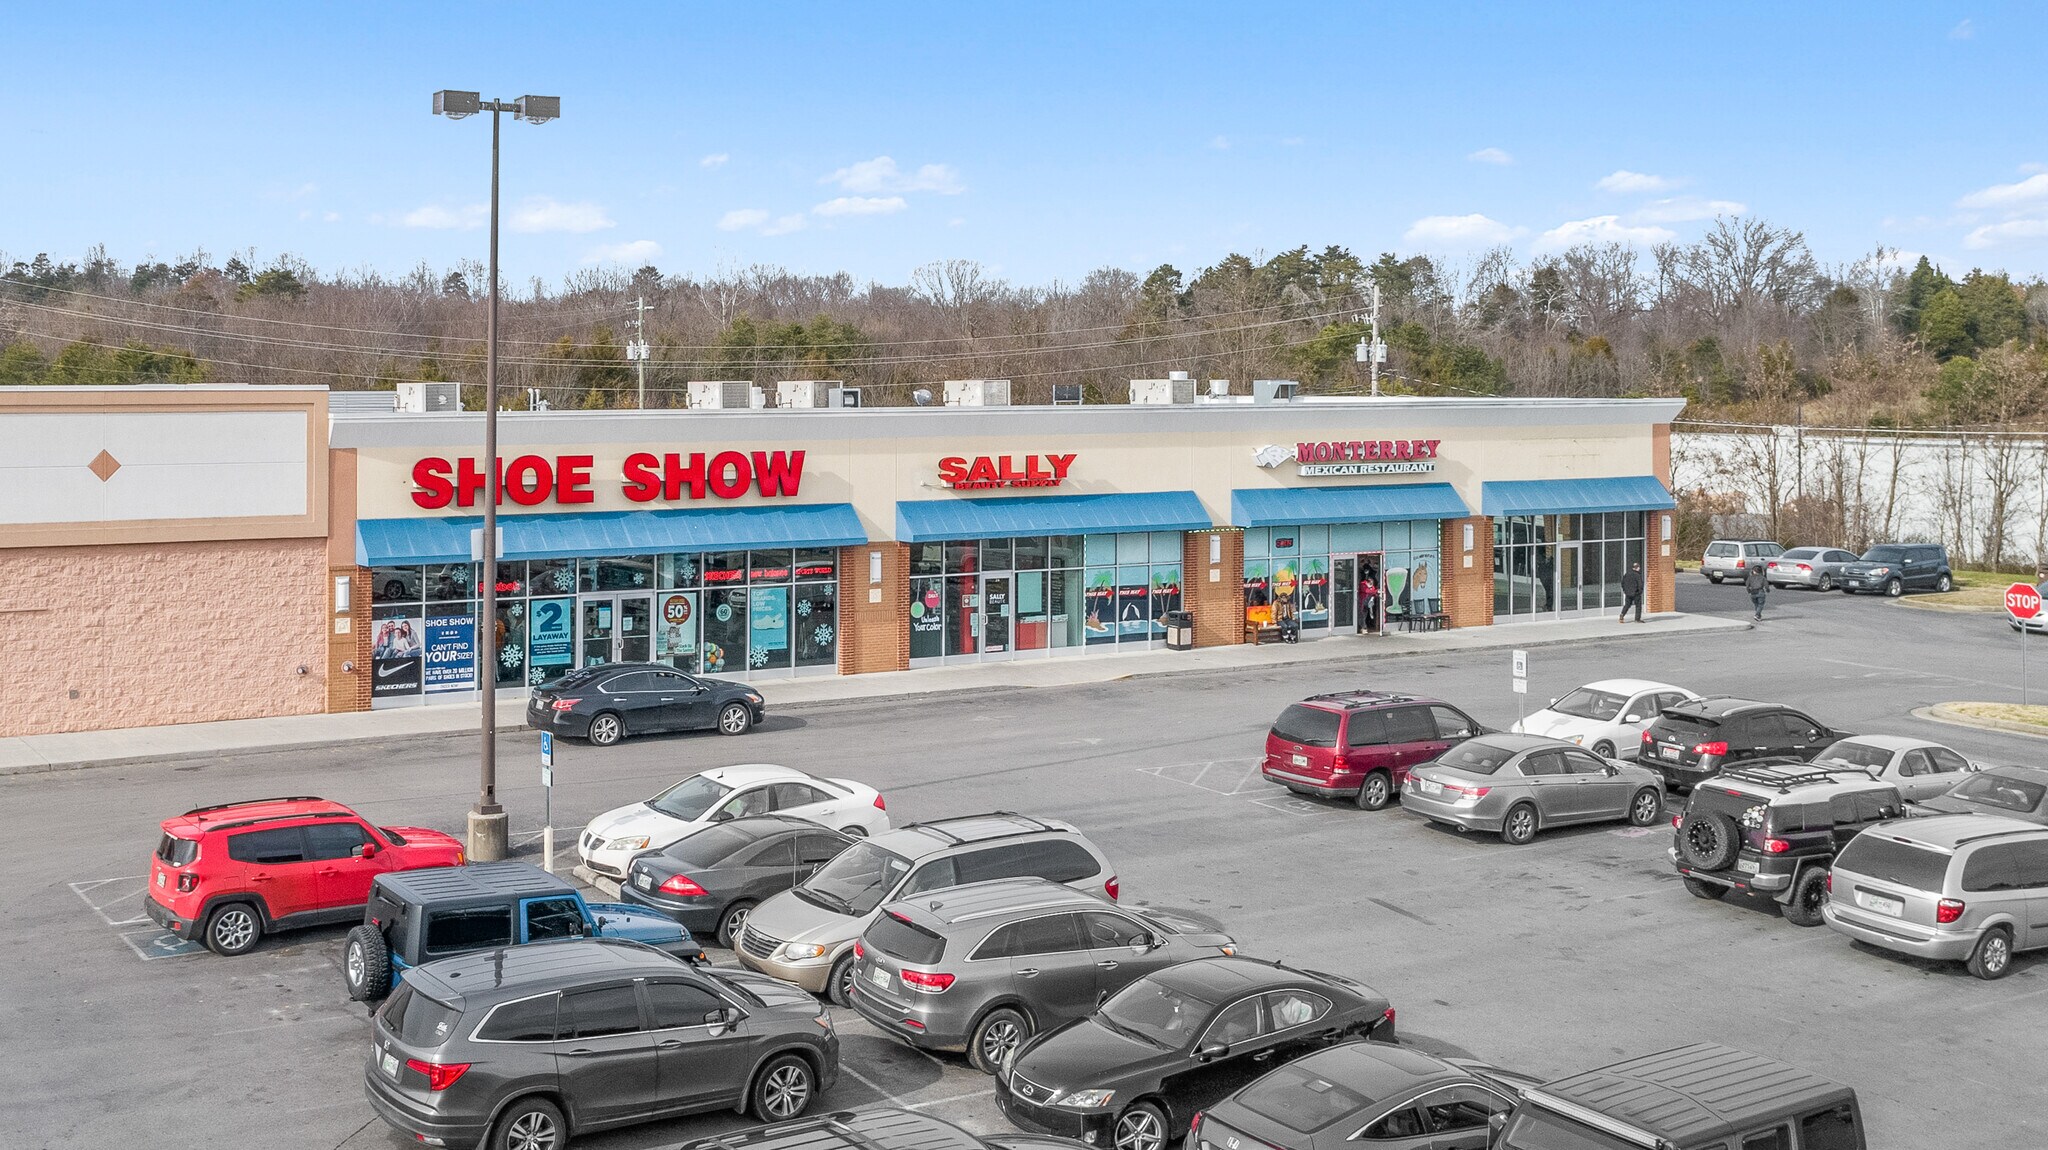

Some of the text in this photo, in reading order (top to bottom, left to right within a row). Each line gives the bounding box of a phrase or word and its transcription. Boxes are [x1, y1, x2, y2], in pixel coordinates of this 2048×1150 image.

[1296, 440, 1441, 463] MONTERREY
[938, 454, 1078, 483] SALLY
[1304, 463, 1434, 475] MEXICAN RESTAURANT
[411, 450, 806, 509] SHOE SHOW
[953, 479, 1063, 490] BEAUTY SUPPLY
[2007, 593, 2039, 609] STOP
[425, 617, 474, 627] SHOE SHOW
[532, 632, 569, 640] LAYAWAY
[431, 642, 469, 651] CAN'T FIND
[425, 651, 474, 663] YOUR SIZE?
[375, 682, 418, 691] SKECHERS
